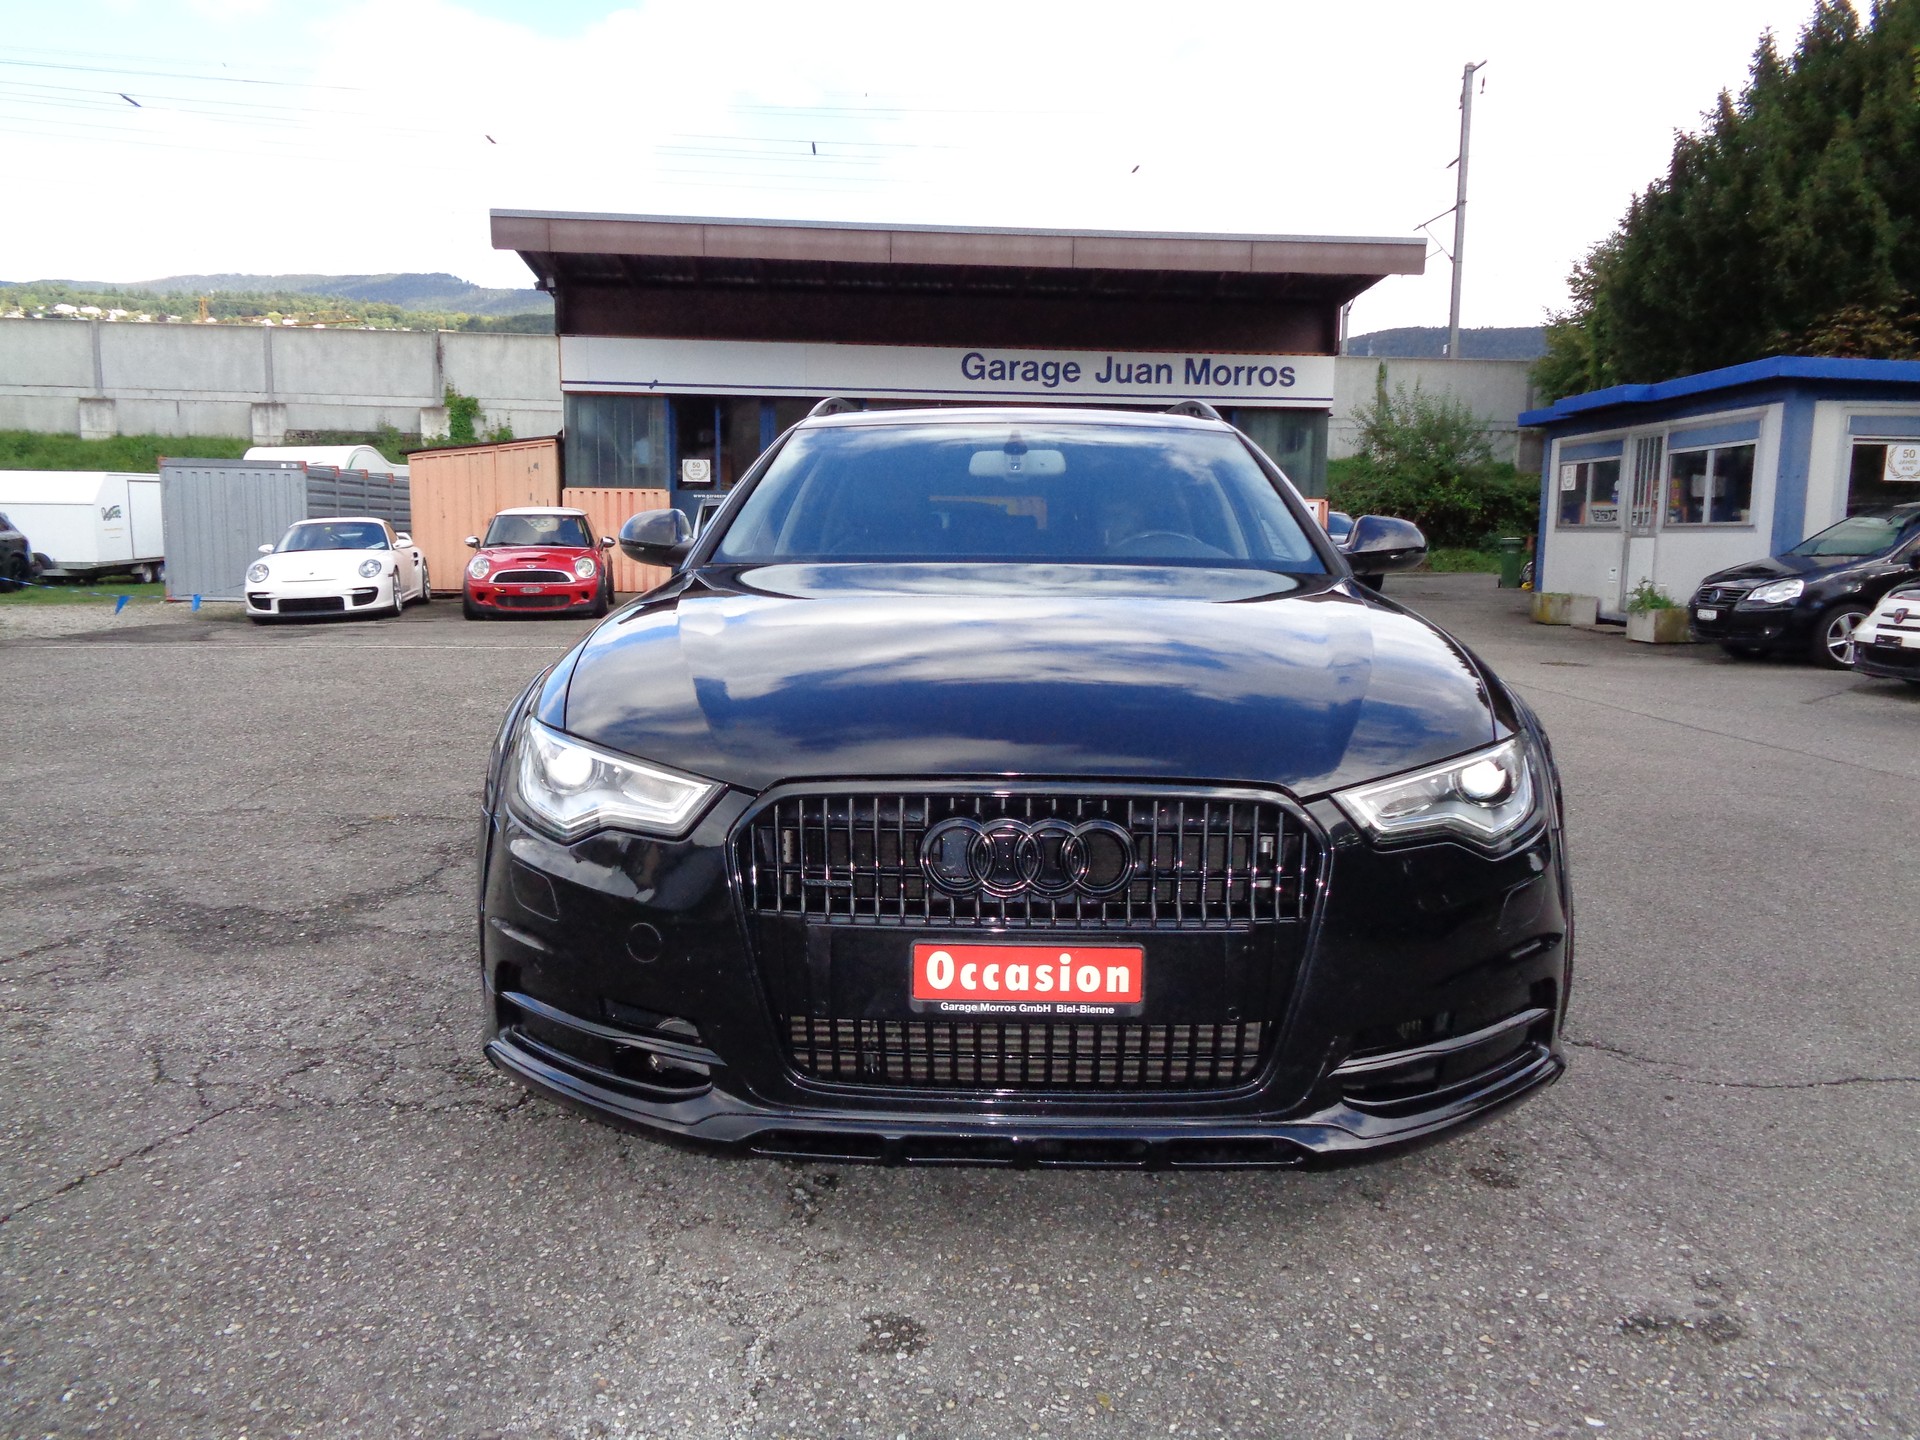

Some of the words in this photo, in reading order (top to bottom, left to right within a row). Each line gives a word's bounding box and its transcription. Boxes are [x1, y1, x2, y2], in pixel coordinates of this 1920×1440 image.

[961, 352, 1081, 387] Garage
[1095, 356, 1173, 384] Juan
[1184, 358, 1296, 387] Morros
[1903, 449, 1916, 458] 50
[926, 951, 1130, 992] Occasion
[940, 1002, 977, 1012] Garage
[980, 1003, 1016, 1012] Morros
[1019, 1003, 1051, 1013] GmbH
[1056, 1004, 1115, 1014] Biel-Bienne
